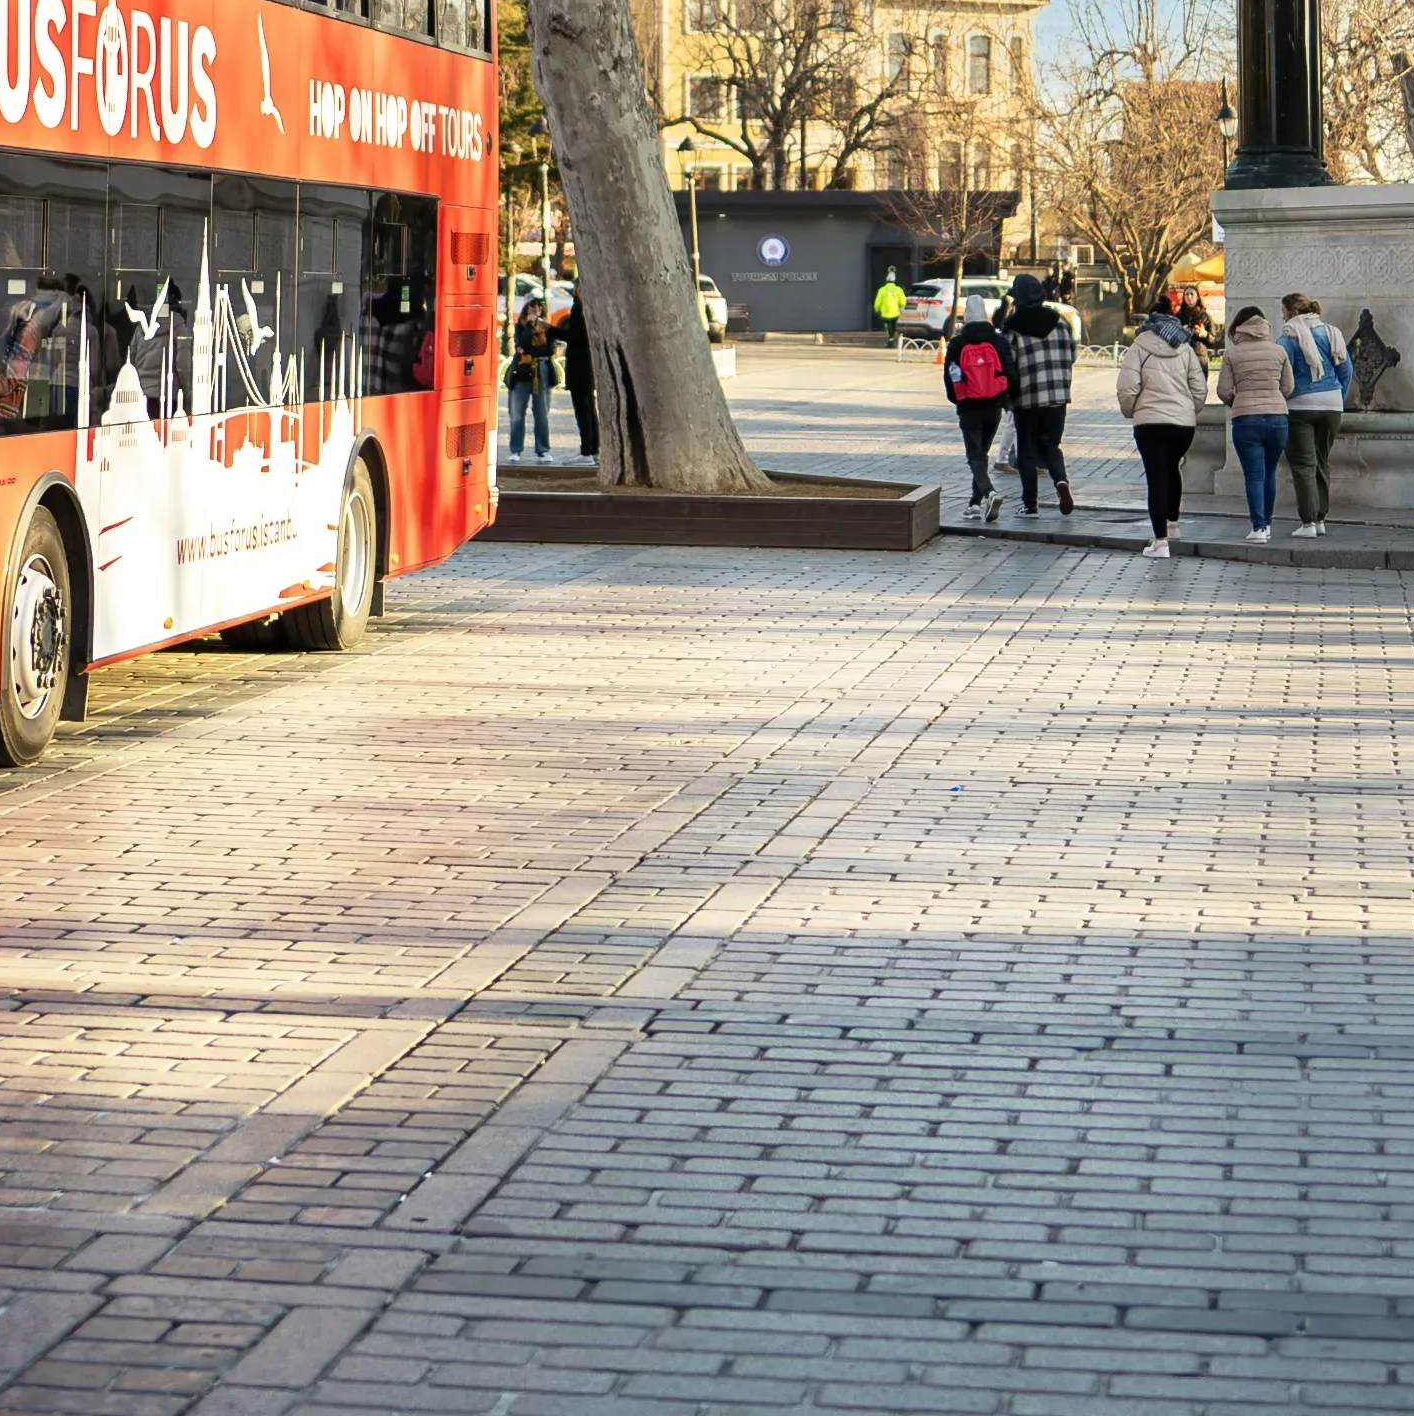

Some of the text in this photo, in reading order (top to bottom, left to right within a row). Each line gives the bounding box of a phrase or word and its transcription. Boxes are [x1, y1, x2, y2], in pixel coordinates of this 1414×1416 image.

[309, 78, 483, 162] HOP ON HOP OFF TOURS
